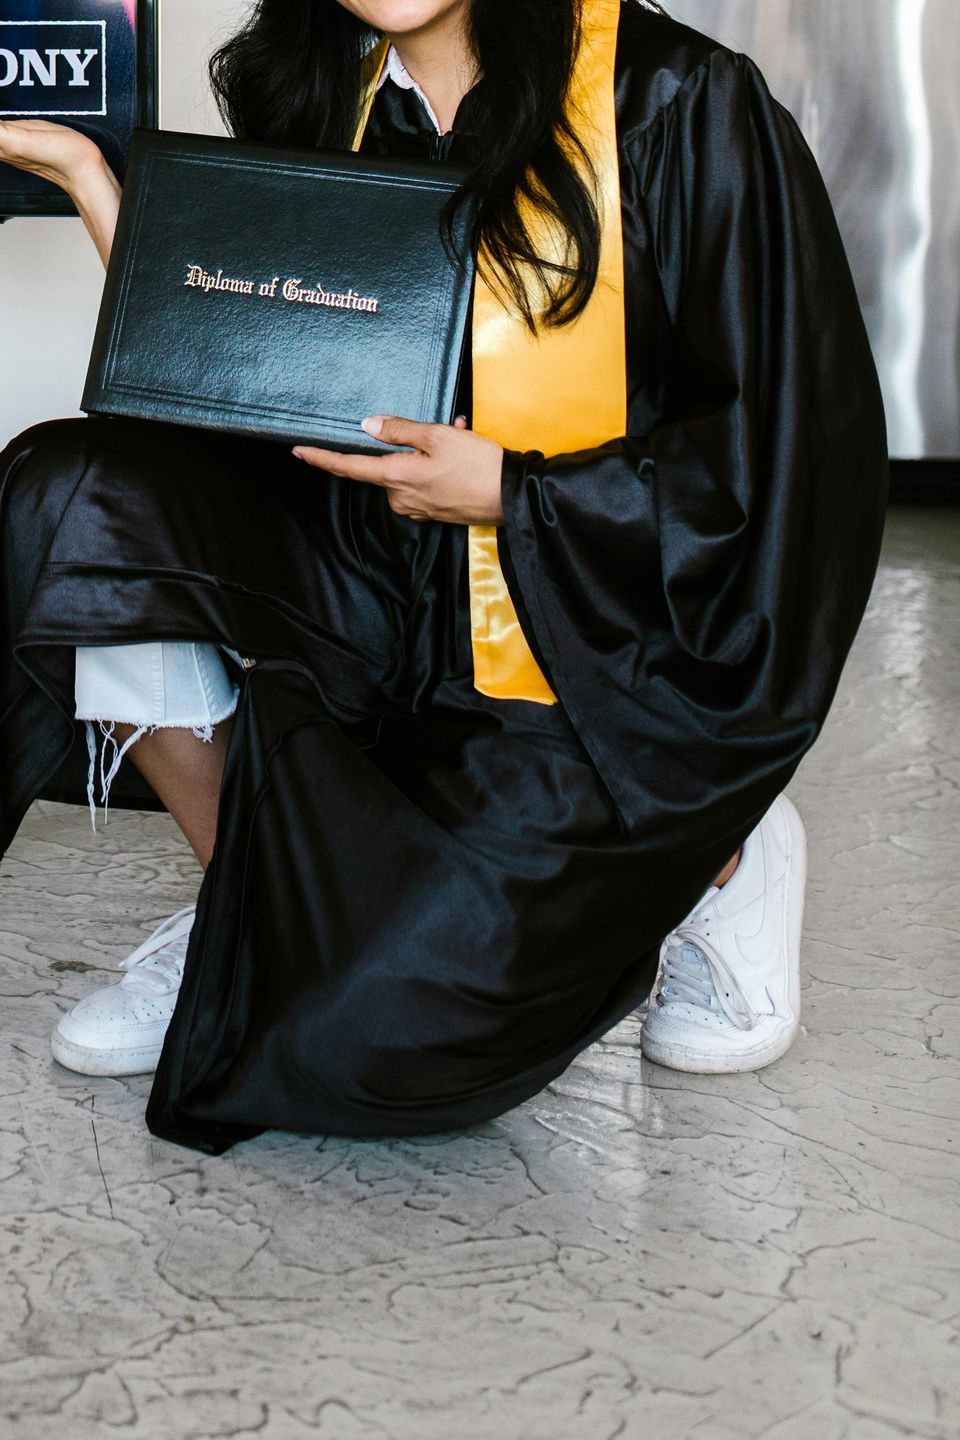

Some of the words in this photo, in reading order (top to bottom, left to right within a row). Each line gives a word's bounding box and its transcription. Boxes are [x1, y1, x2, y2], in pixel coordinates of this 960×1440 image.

[184, 264, 254, 293] Diploma
[258, 276, 279, 297] of
[282, 278, 379, 312] Graduation
